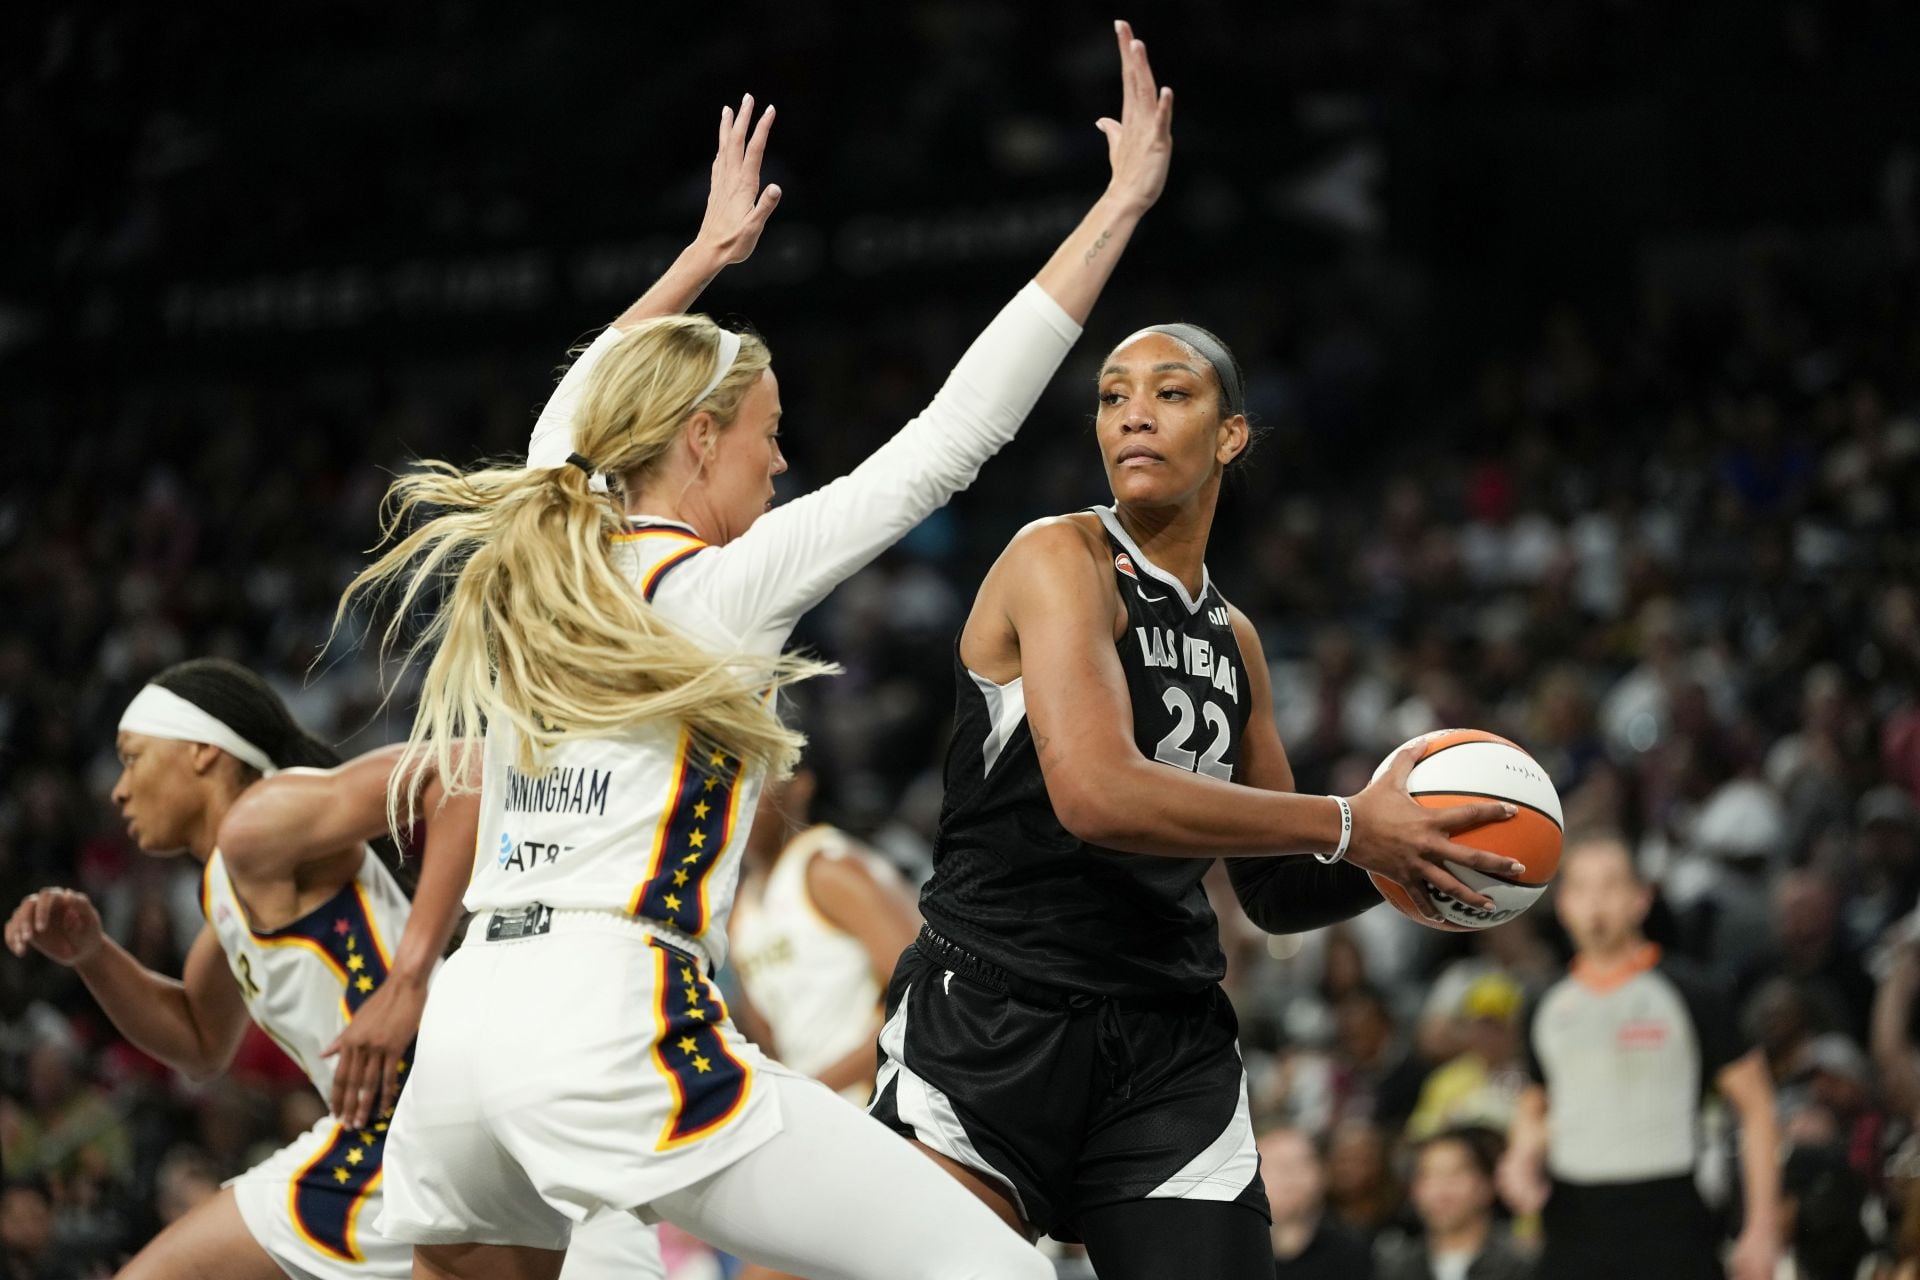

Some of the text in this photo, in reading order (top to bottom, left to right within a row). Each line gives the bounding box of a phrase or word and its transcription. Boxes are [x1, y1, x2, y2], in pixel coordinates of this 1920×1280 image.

[1136, 627, 1178, 669] LAS
[1154, 686, 1234, 782] 22
[504, 765, 612, 816] UNNINGHAM
[505, 840, 576, 872] AT&
